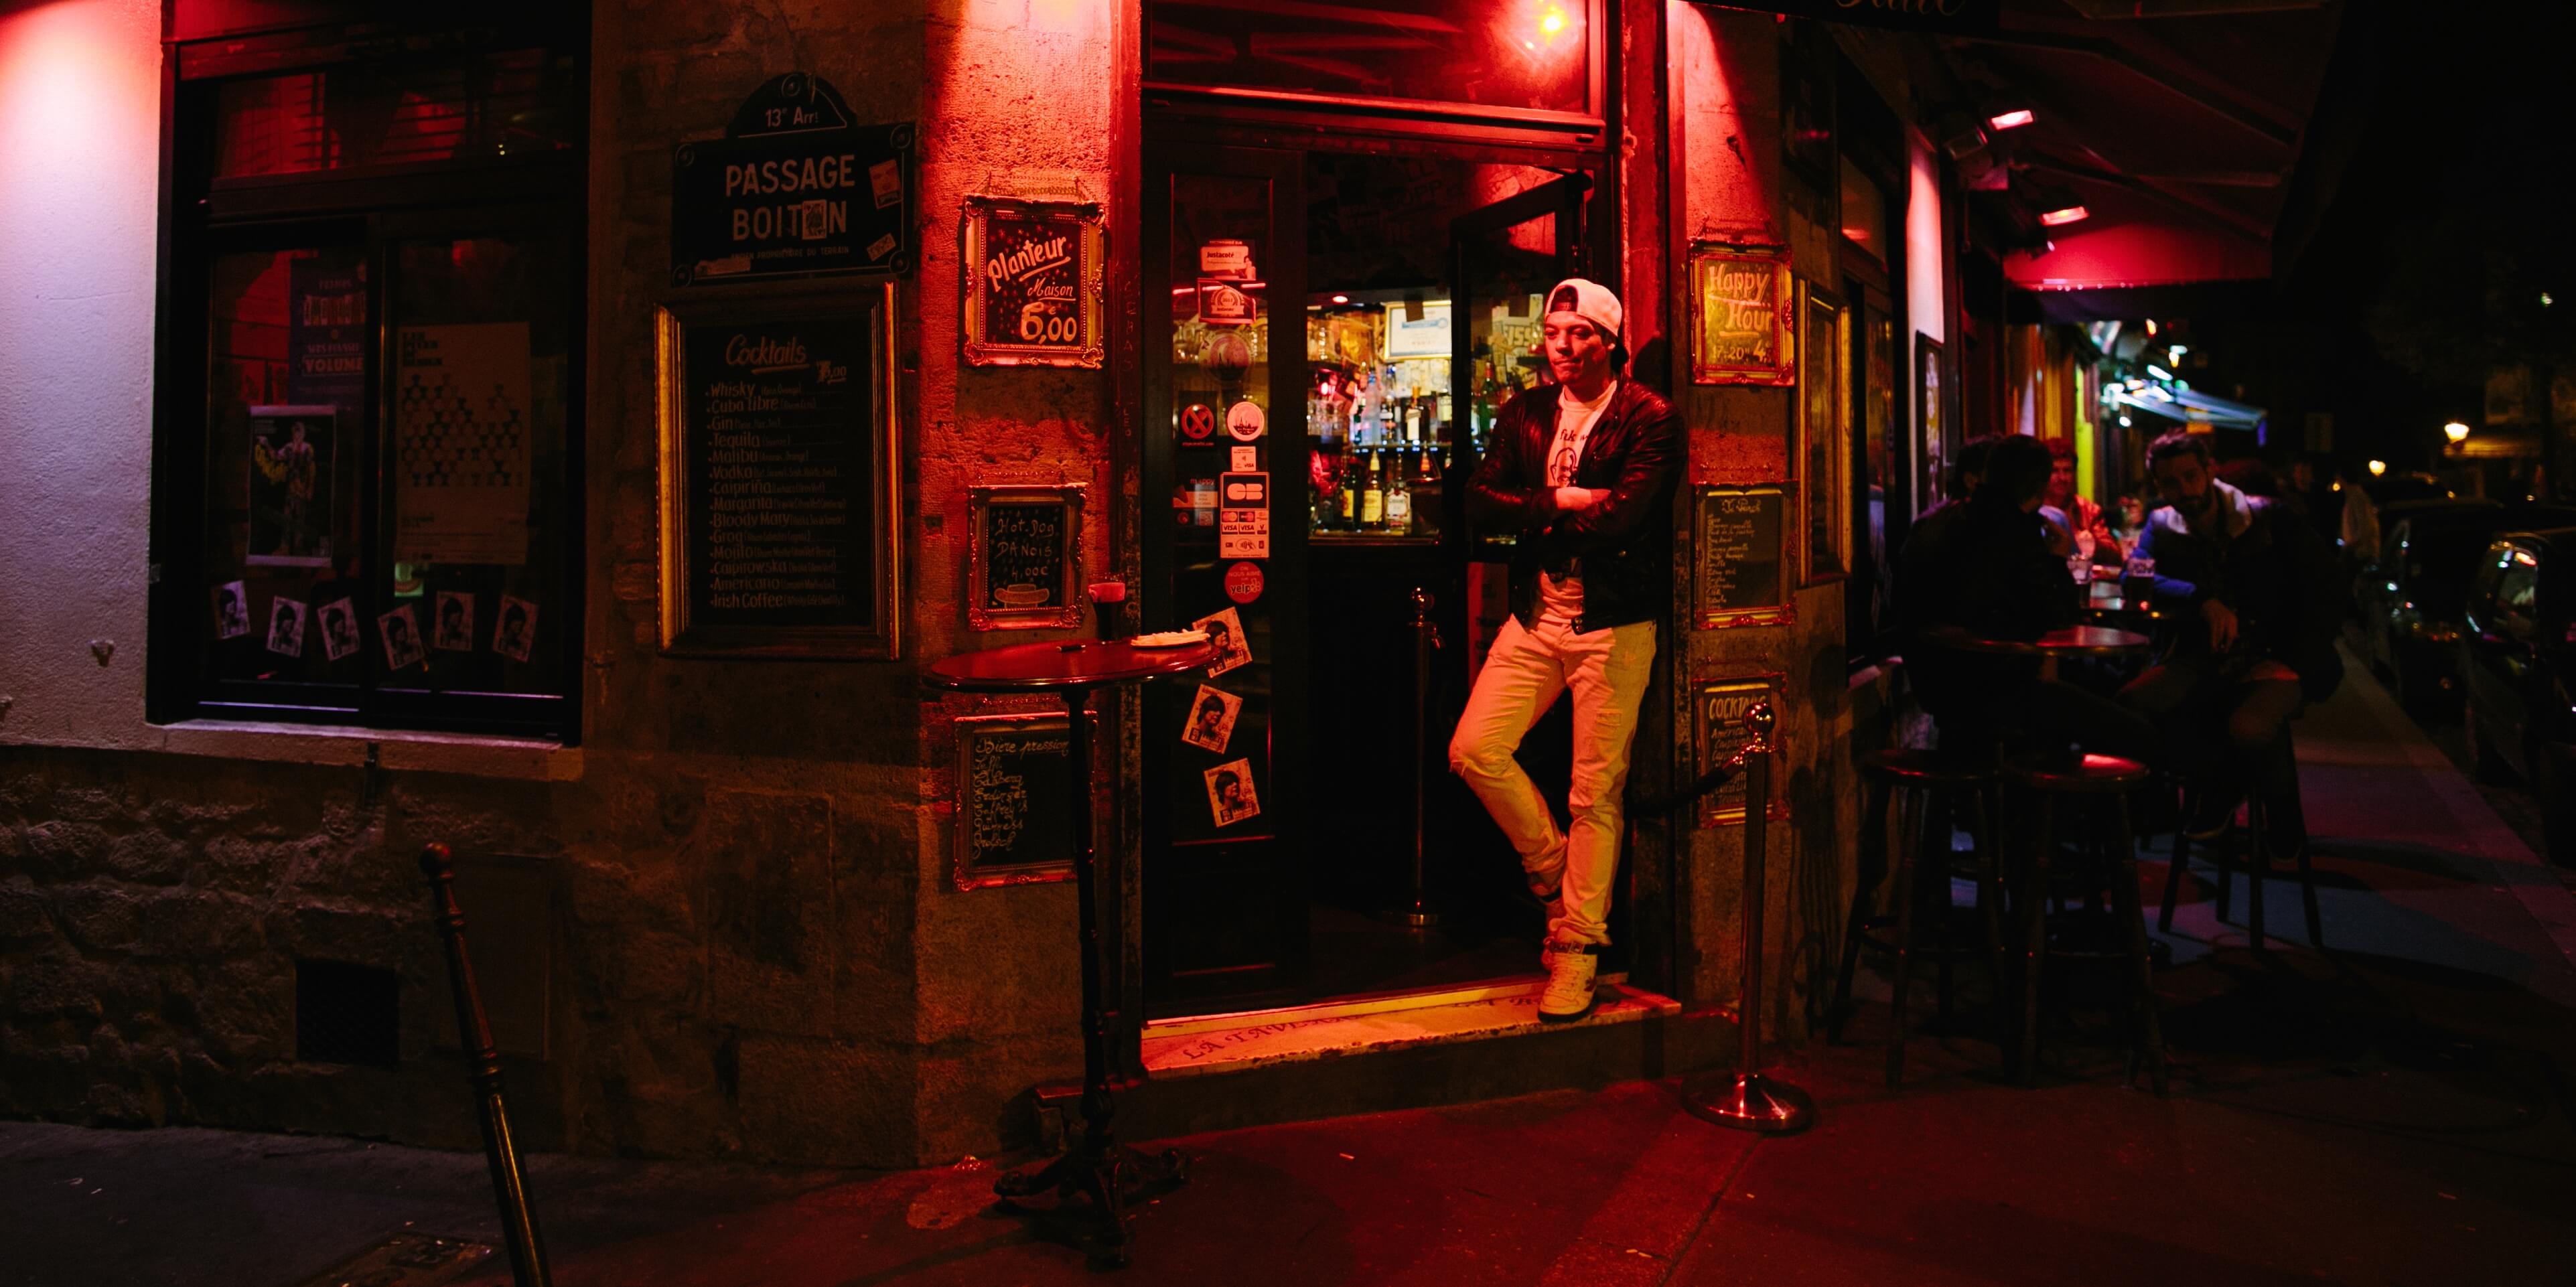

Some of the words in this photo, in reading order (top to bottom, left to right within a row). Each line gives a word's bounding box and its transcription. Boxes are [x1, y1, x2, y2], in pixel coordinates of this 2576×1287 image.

[724, 154, 855, 198] PASSAGE
[732, 200, 847, 242] BOITN
[987, 237, 1067, 293] Planteur
[1027, 277, 1073, 297] Maison
[1709, 263, 1772, 301] Happy
[1725, 302, 1774, 333] Hour
[725, 333, 808, 365] Cocktails
[710, 380, 756, 399] Whisky
[712, 416, 734, 431] Gin
[713, 431, 762, 449] Tequila
[712, 449, 758, 463] Malibu
[712, 465, 753, 479] Vodka
[713, 512, 758, 528] Bloody
[760, 512, 791, 528] Mary
[713, 545, 754, 560] Mojito
[713, 576, 780, 591] Americano
[1230, 583, 1251, 595] yelp
[713, 593, 740, 608] Irish
[741, 593, 784, 608] Coffee
